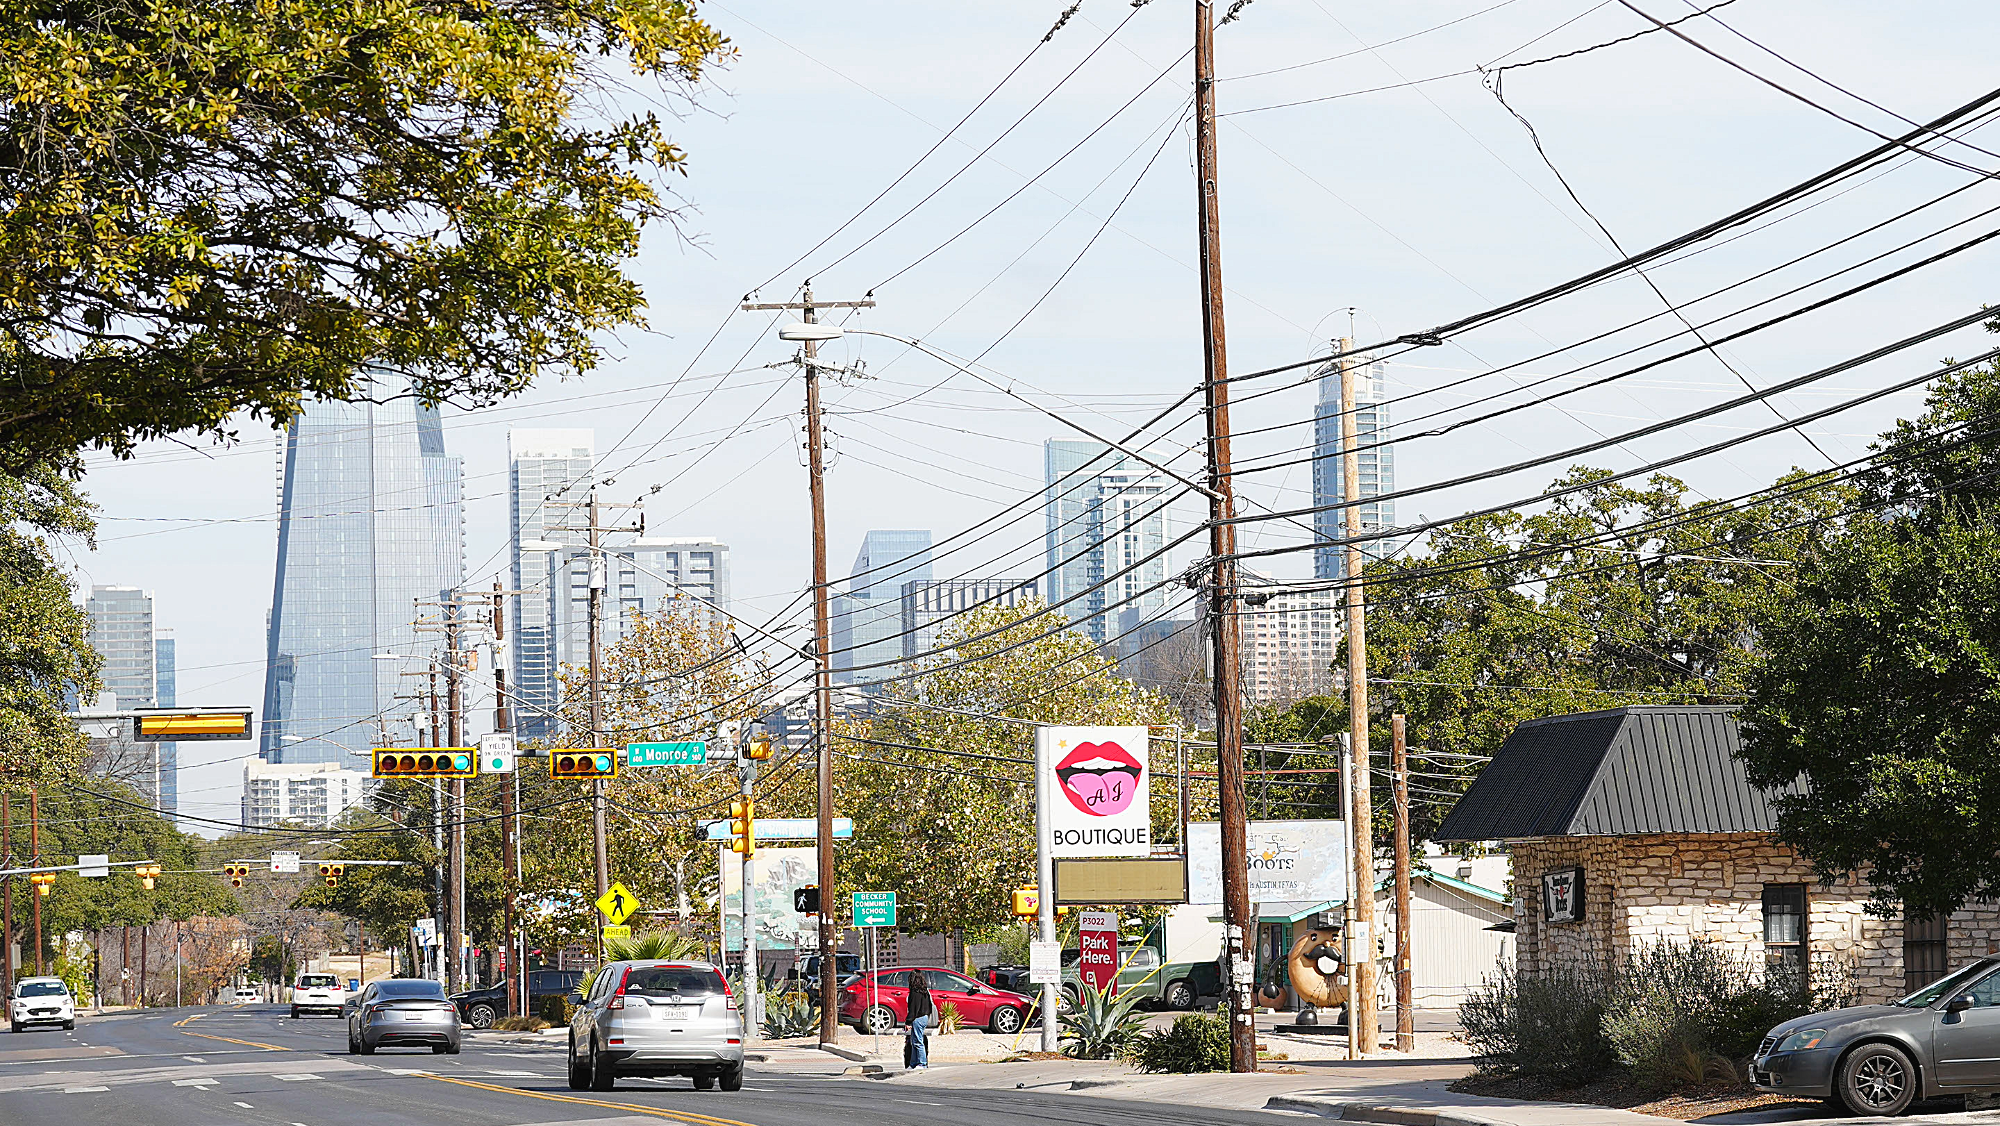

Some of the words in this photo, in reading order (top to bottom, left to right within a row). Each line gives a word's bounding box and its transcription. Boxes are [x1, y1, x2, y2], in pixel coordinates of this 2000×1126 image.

[645, 748, 688, 761] Monroe
[1054, 828, 1146, 845] BOUTIQUE
[1082, 917, 1105, 926] P3022
[1082, 936, 1109, 950] Park
[1082, 950, 1114, 965] Here.
